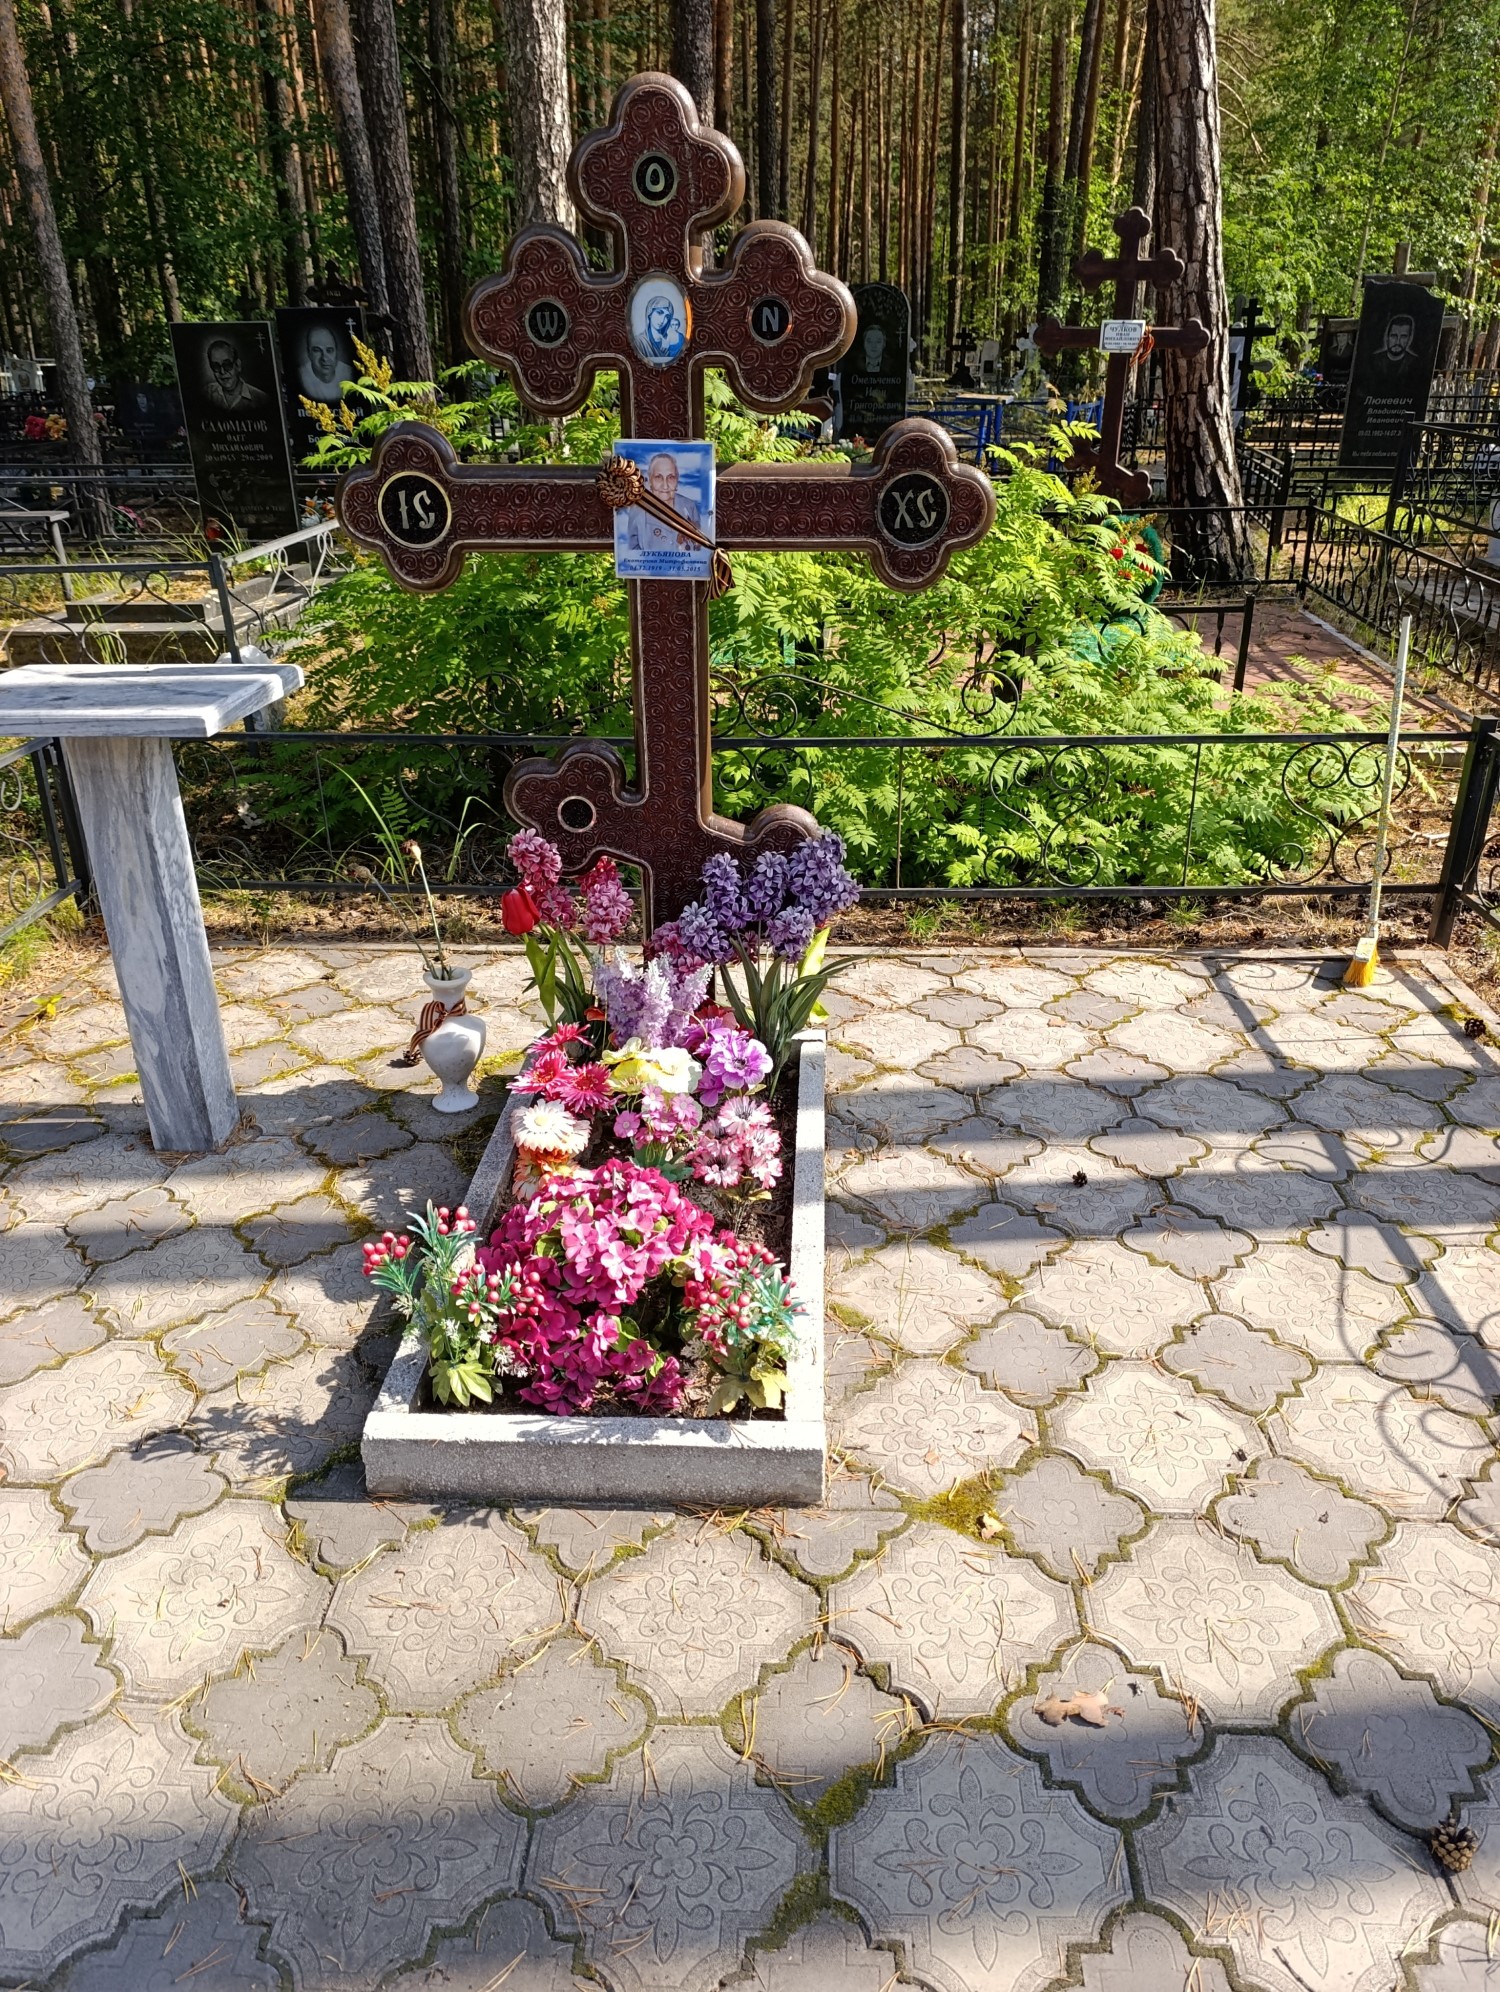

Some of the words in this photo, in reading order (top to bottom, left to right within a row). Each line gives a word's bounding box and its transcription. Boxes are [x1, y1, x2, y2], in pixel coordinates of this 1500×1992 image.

[851, 374, 902, 385] Омельченко
[1363, 395, 1413, 405] Люкевич
[1366, 407, 1406, 416] Владимир
[1366, 416, 1404, 424] Иванович
[201, 420, 268, 432] САЛОМАТОВ
[639, 550, 692, 558] ЛУКЬЯНОВА
[659, 558, 707, 566] Митрофановна
